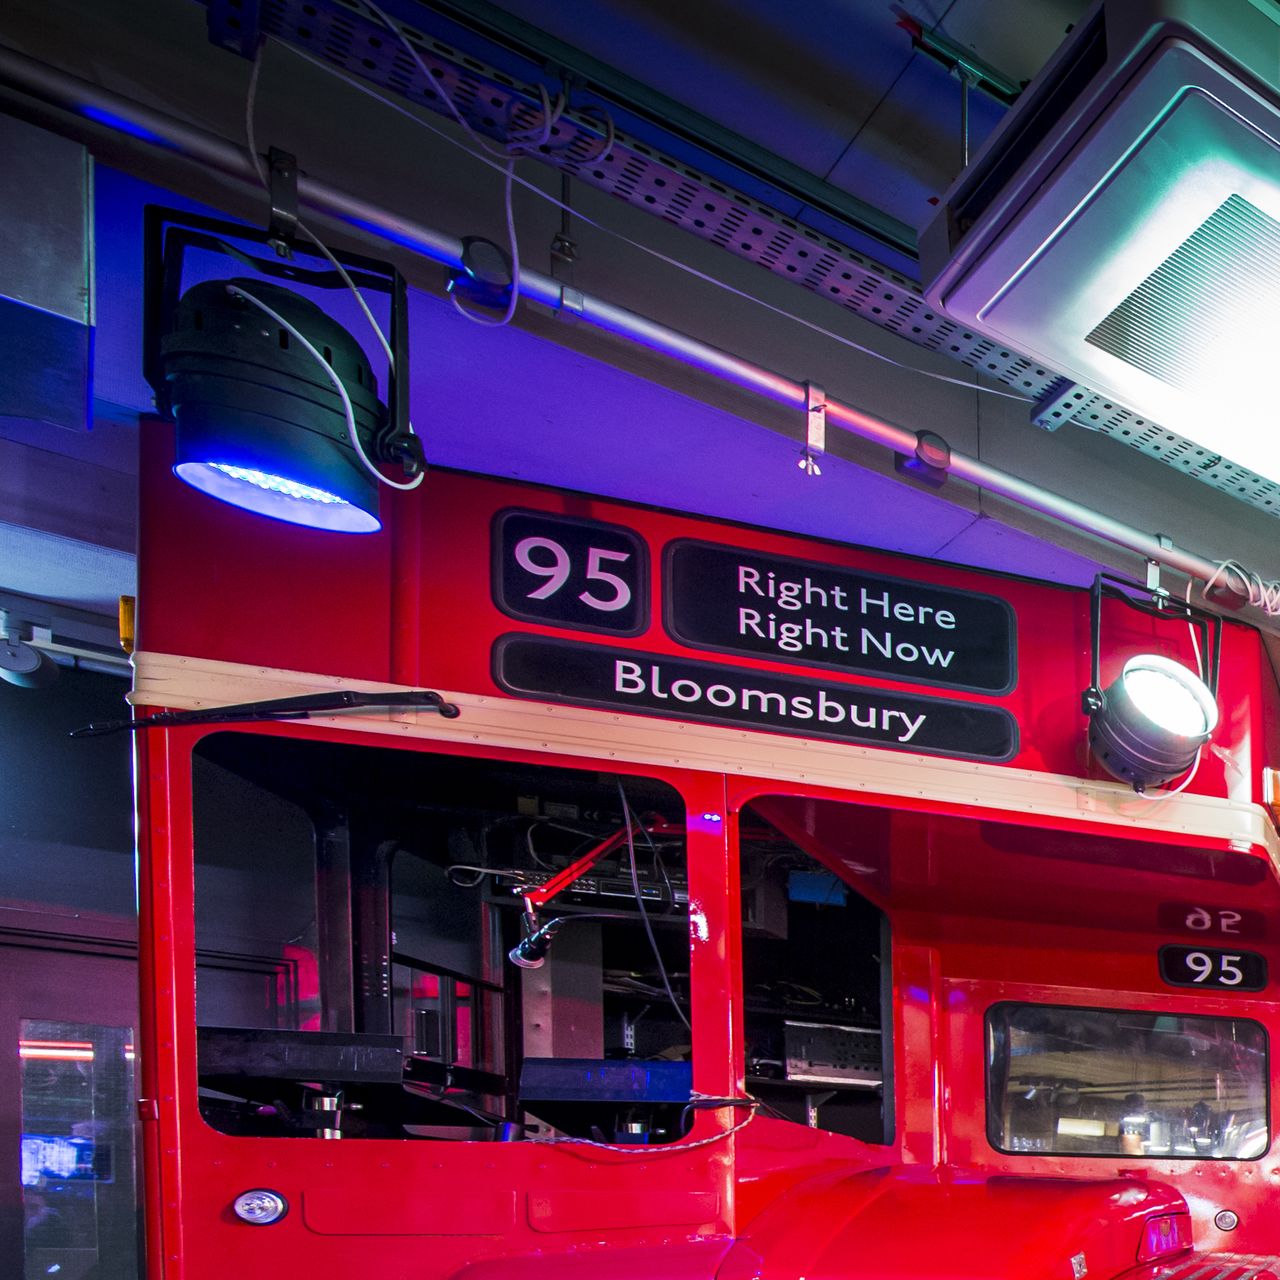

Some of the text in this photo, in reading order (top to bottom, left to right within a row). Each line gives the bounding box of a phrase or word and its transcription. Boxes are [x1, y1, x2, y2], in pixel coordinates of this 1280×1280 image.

[514, 536, 632, 612] 95
[738, 565, 957, 630] Right Here
[739, 607, 956, 669] Right Now
[615, 660, 927, 742] Bloomsbury
[1185, 951, 1243, 985] 95
